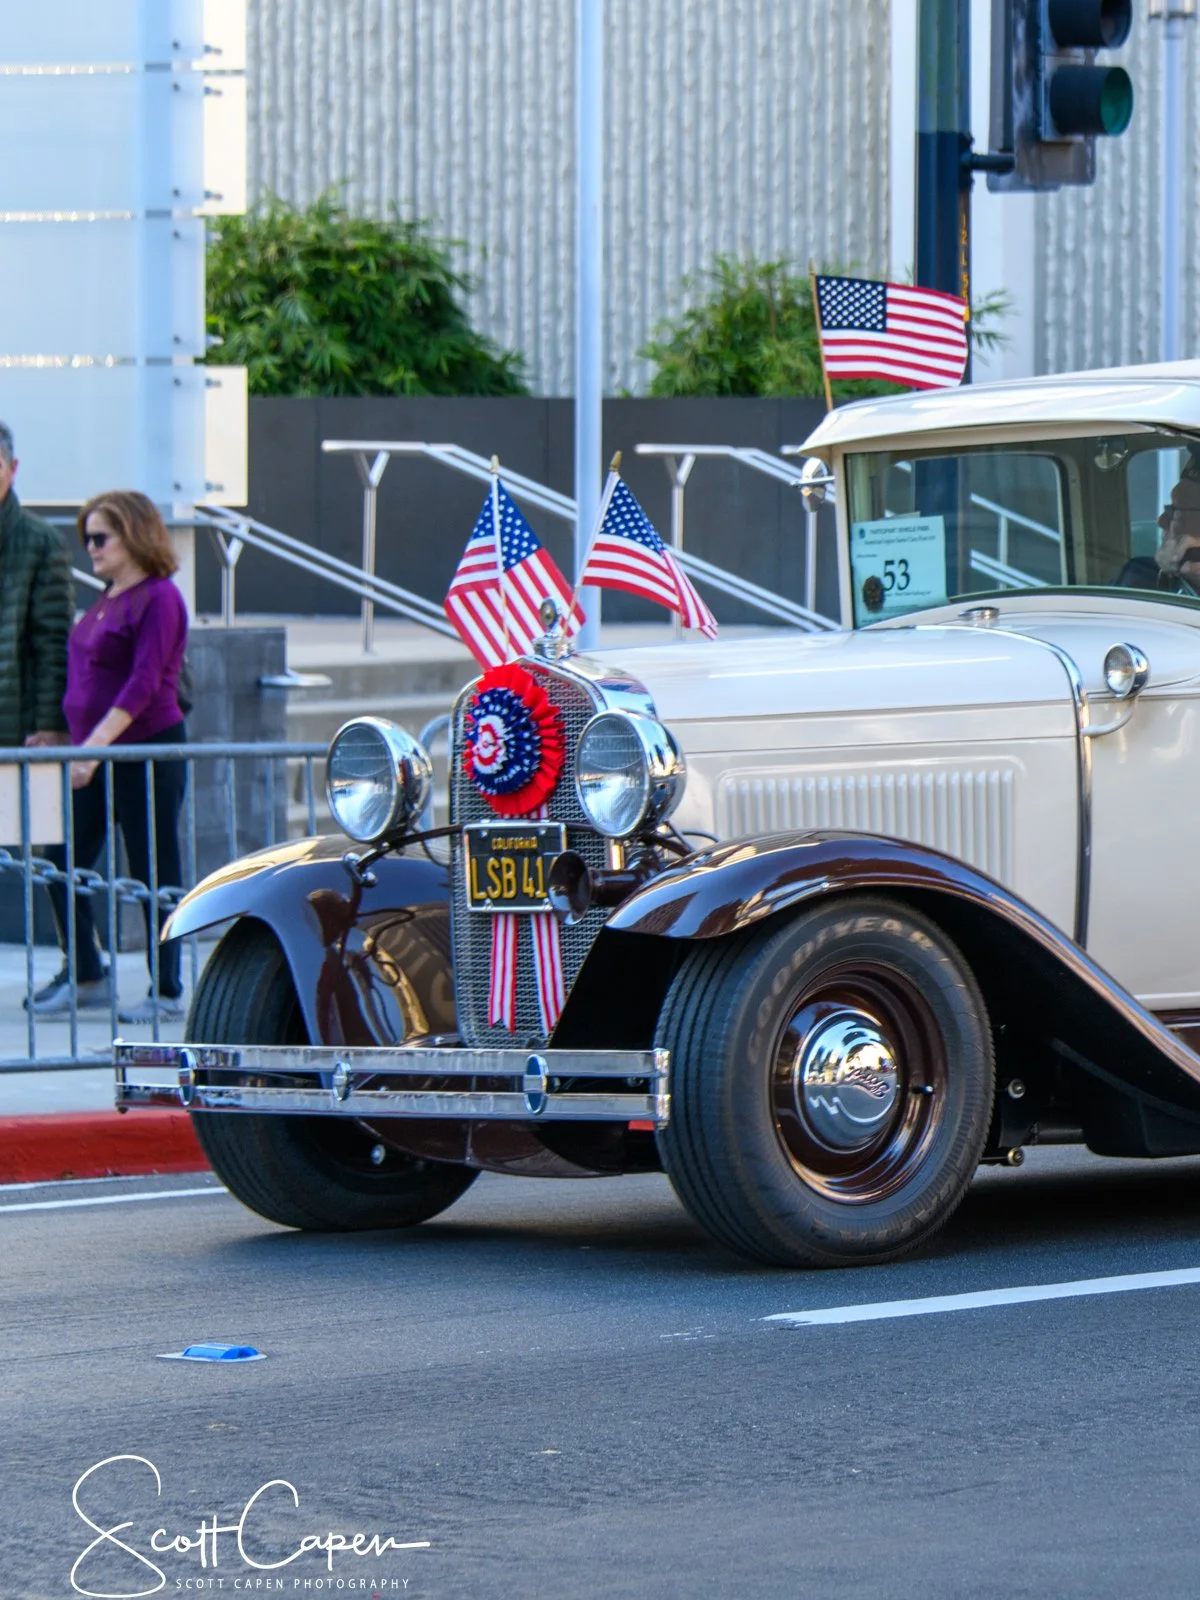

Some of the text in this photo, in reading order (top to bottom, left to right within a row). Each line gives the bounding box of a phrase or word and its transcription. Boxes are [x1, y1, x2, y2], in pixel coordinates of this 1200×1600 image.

[883, 558, 911, 591] 53
[491, 836, 538, 849] CALIFORNIA
[522, 856, 557, 898] 41
